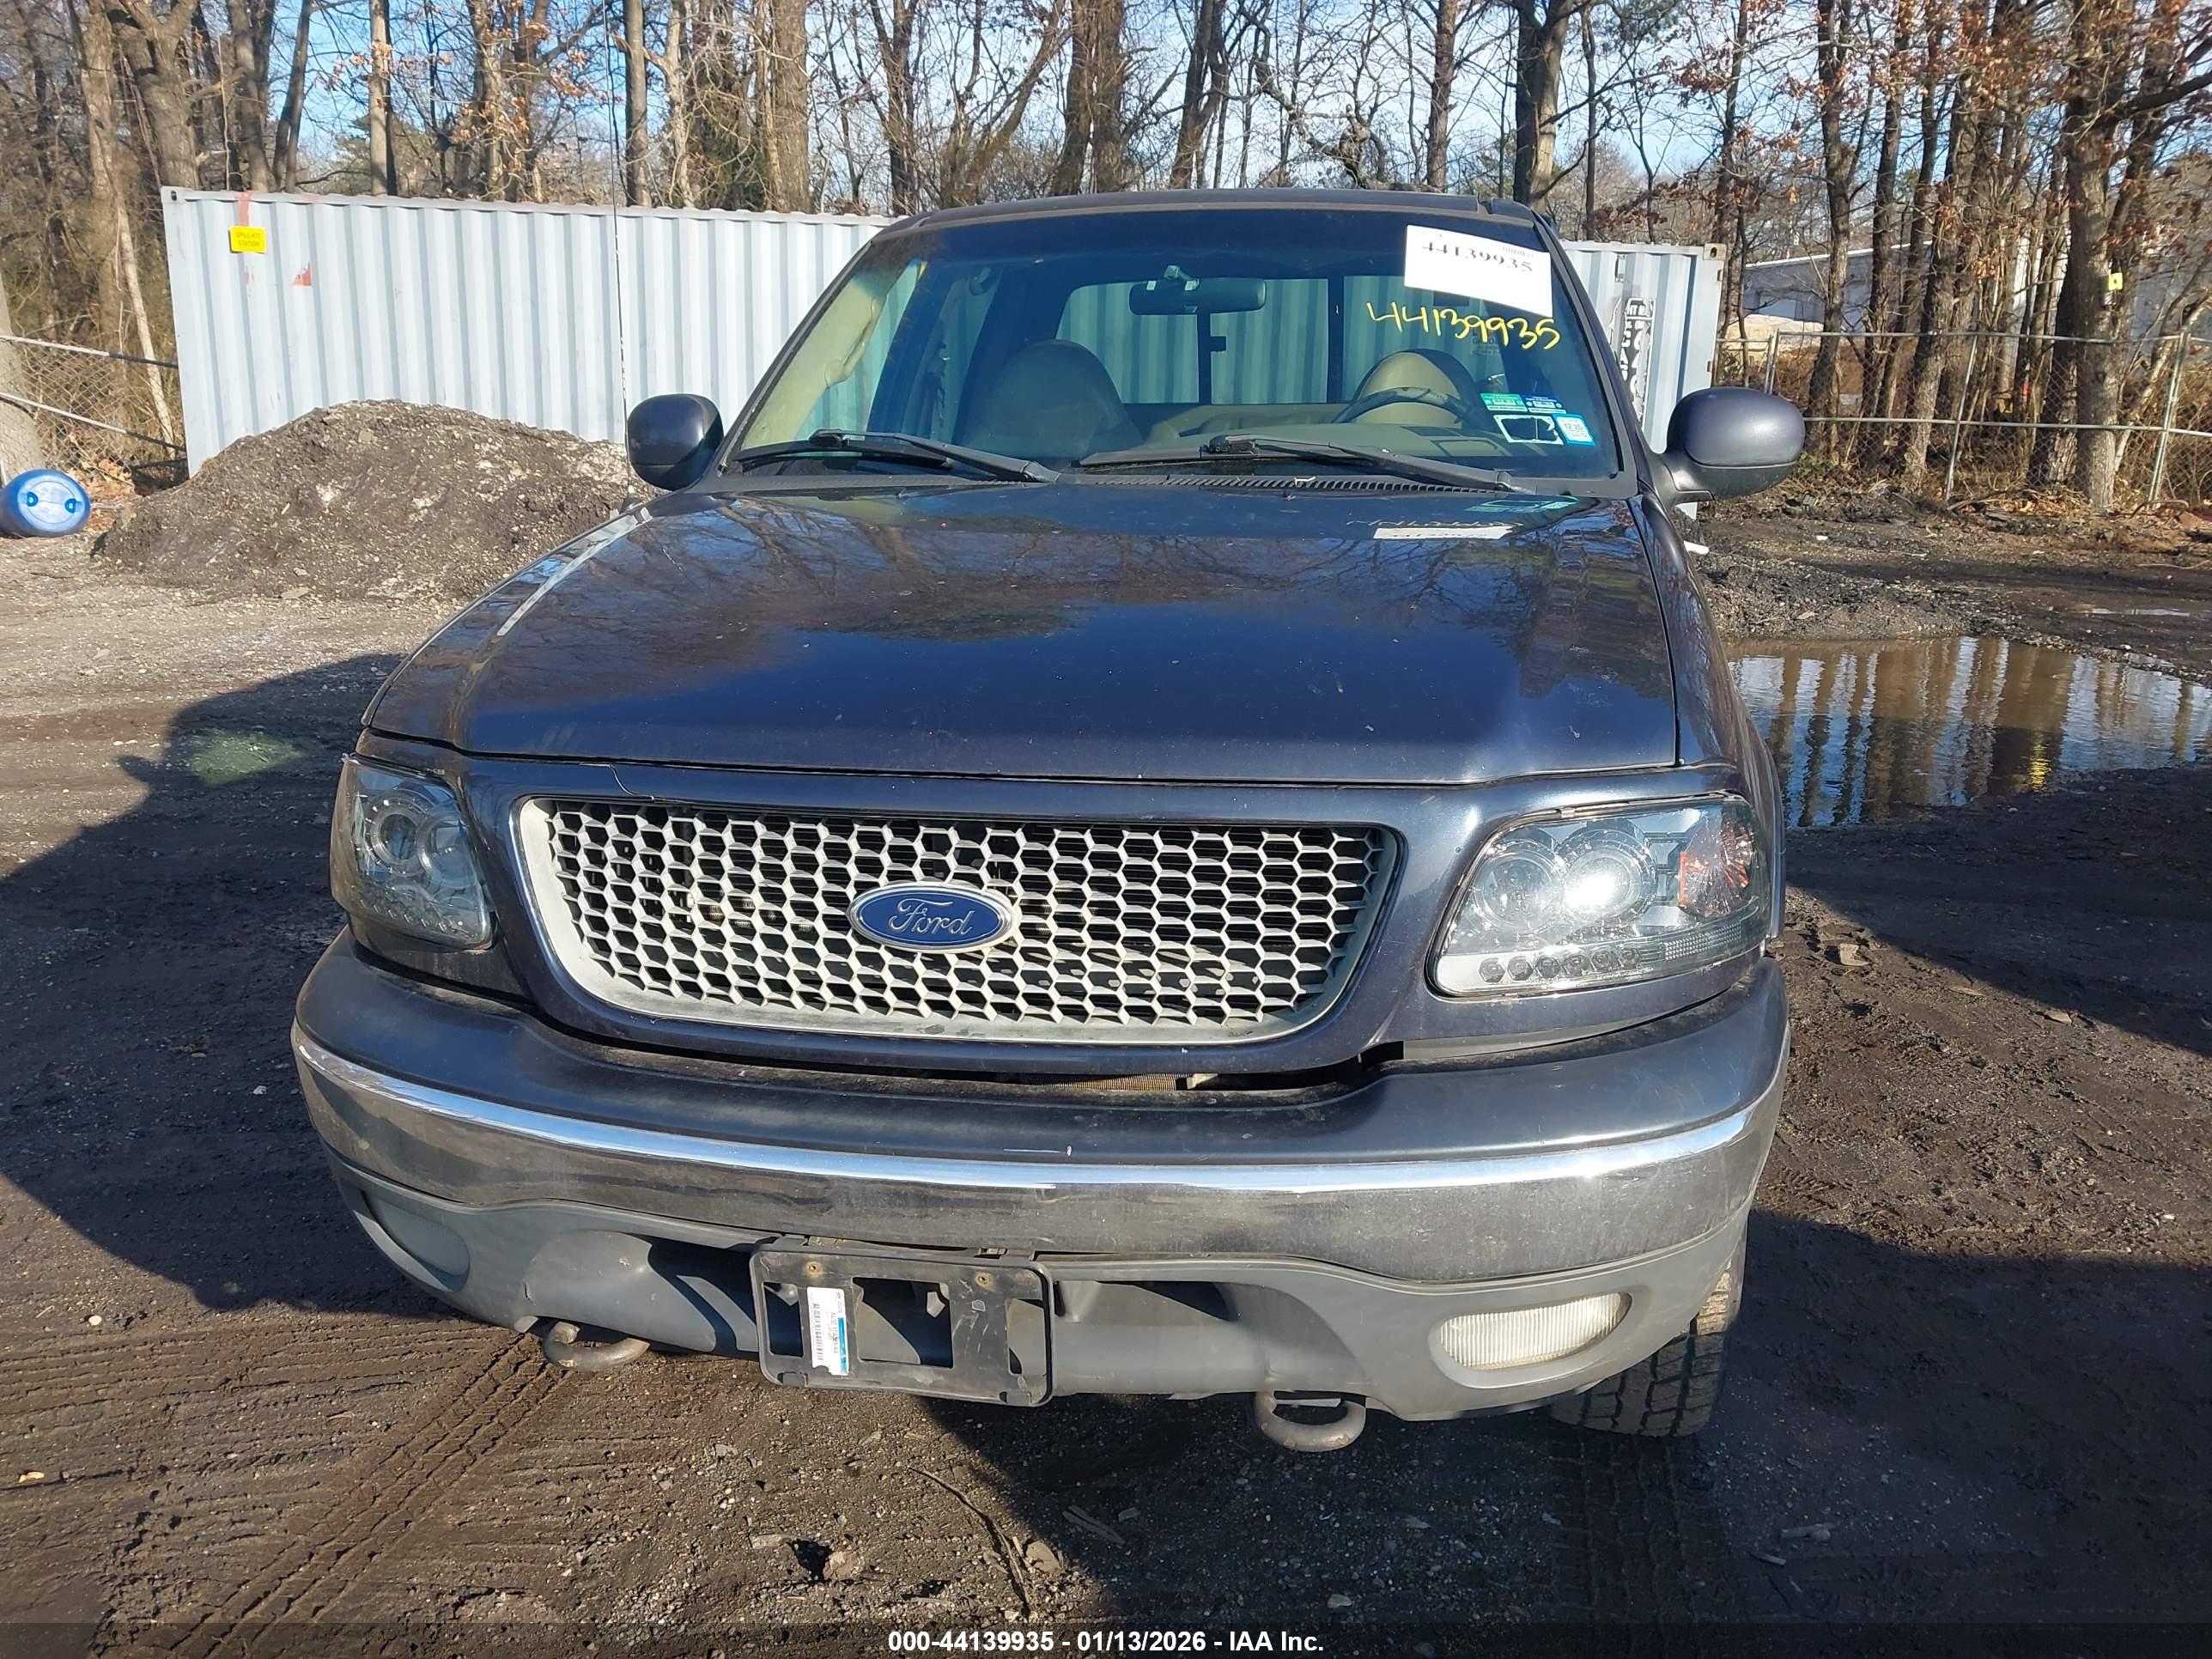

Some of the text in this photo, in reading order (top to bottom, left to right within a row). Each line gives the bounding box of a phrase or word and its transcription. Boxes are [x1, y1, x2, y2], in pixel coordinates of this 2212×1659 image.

[1422, 241, 1533, 272] 44139935
[1366, 301, 1560, 349] 44139935
[889, 898, 975, 935] Ford
